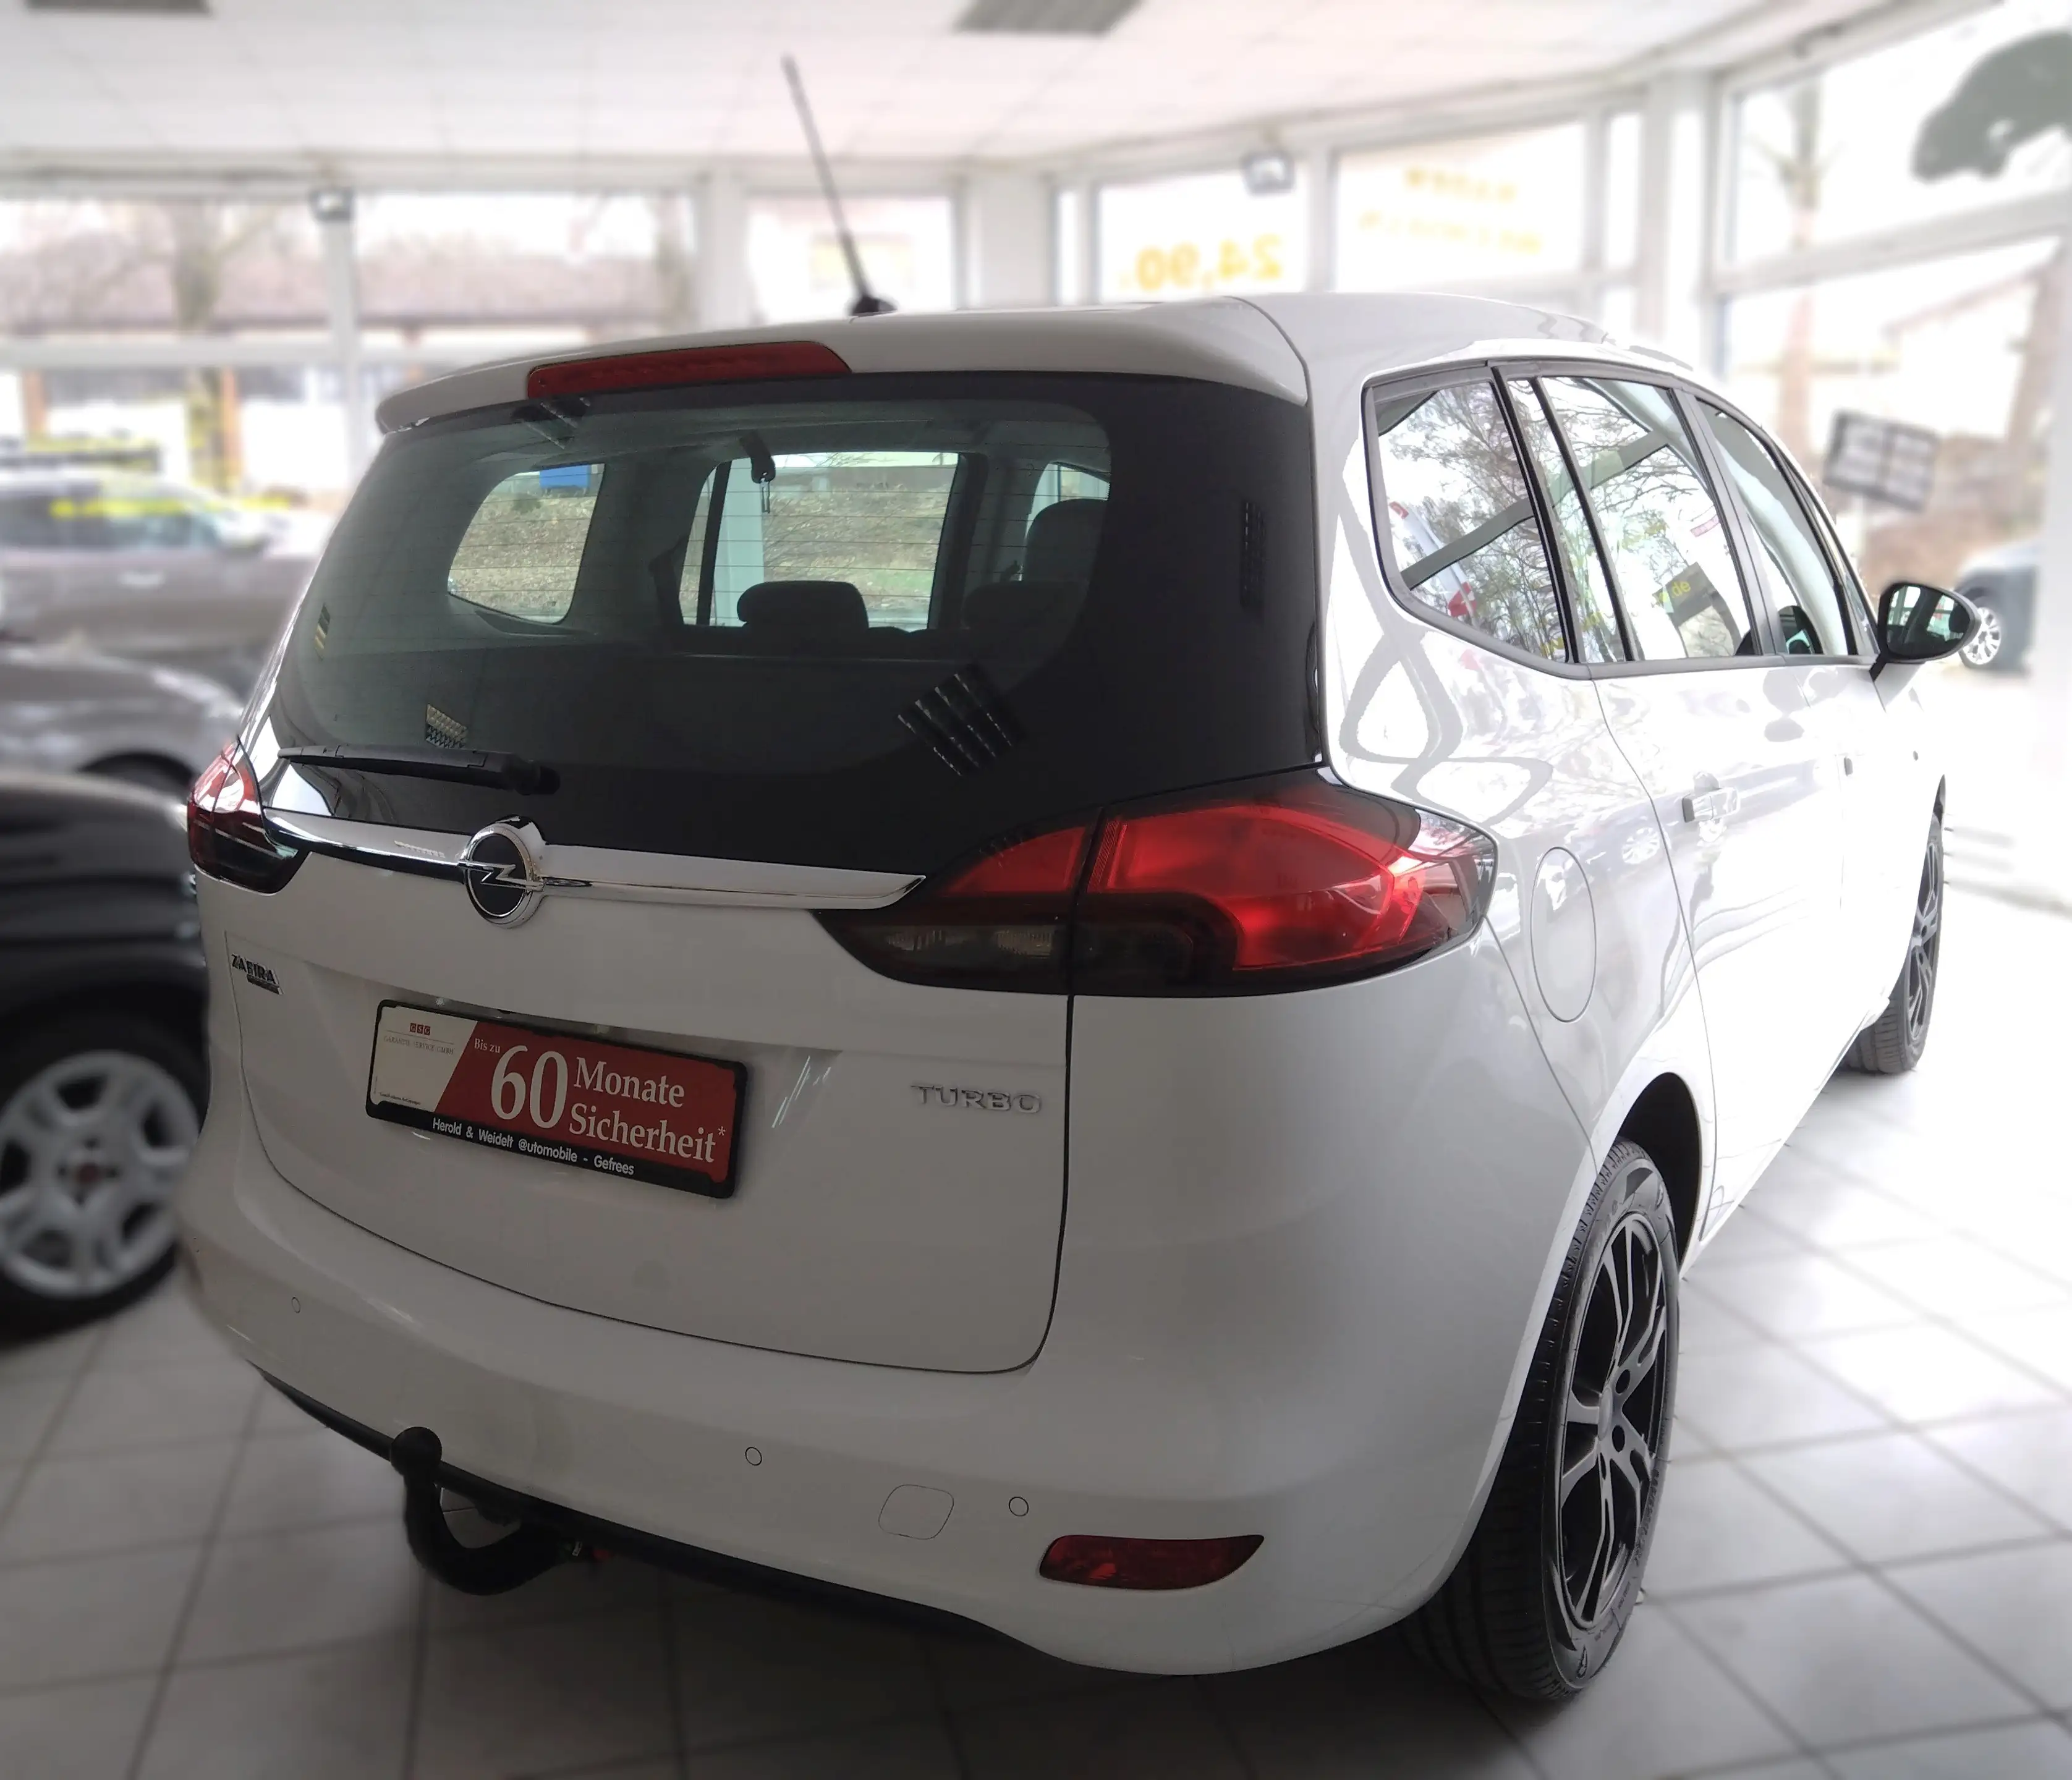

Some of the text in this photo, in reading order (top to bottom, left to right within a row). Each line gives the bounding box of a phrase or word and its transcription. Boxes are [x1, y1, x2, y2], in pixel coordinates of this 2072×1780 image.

[231, 953, 280, 986] ZAFIRA
[414, 1040, 435, 1052] ERVICE
[474, 1038, 500, 1053] Bis zu
[491, 1045, 568, 1129] 60
[574, 1057, 685, 1108] Monate
[911, 1084, 1043, 1114] TURBO
[433, 1117, 462, 1136] Herold
[466, 1125, 473, 1139] &
[478, 1128, 514, 1149] Weidelt
[518, 1138, 578, 1163] @utomobile
[593, 1155, 635, 1176] Gefrees
